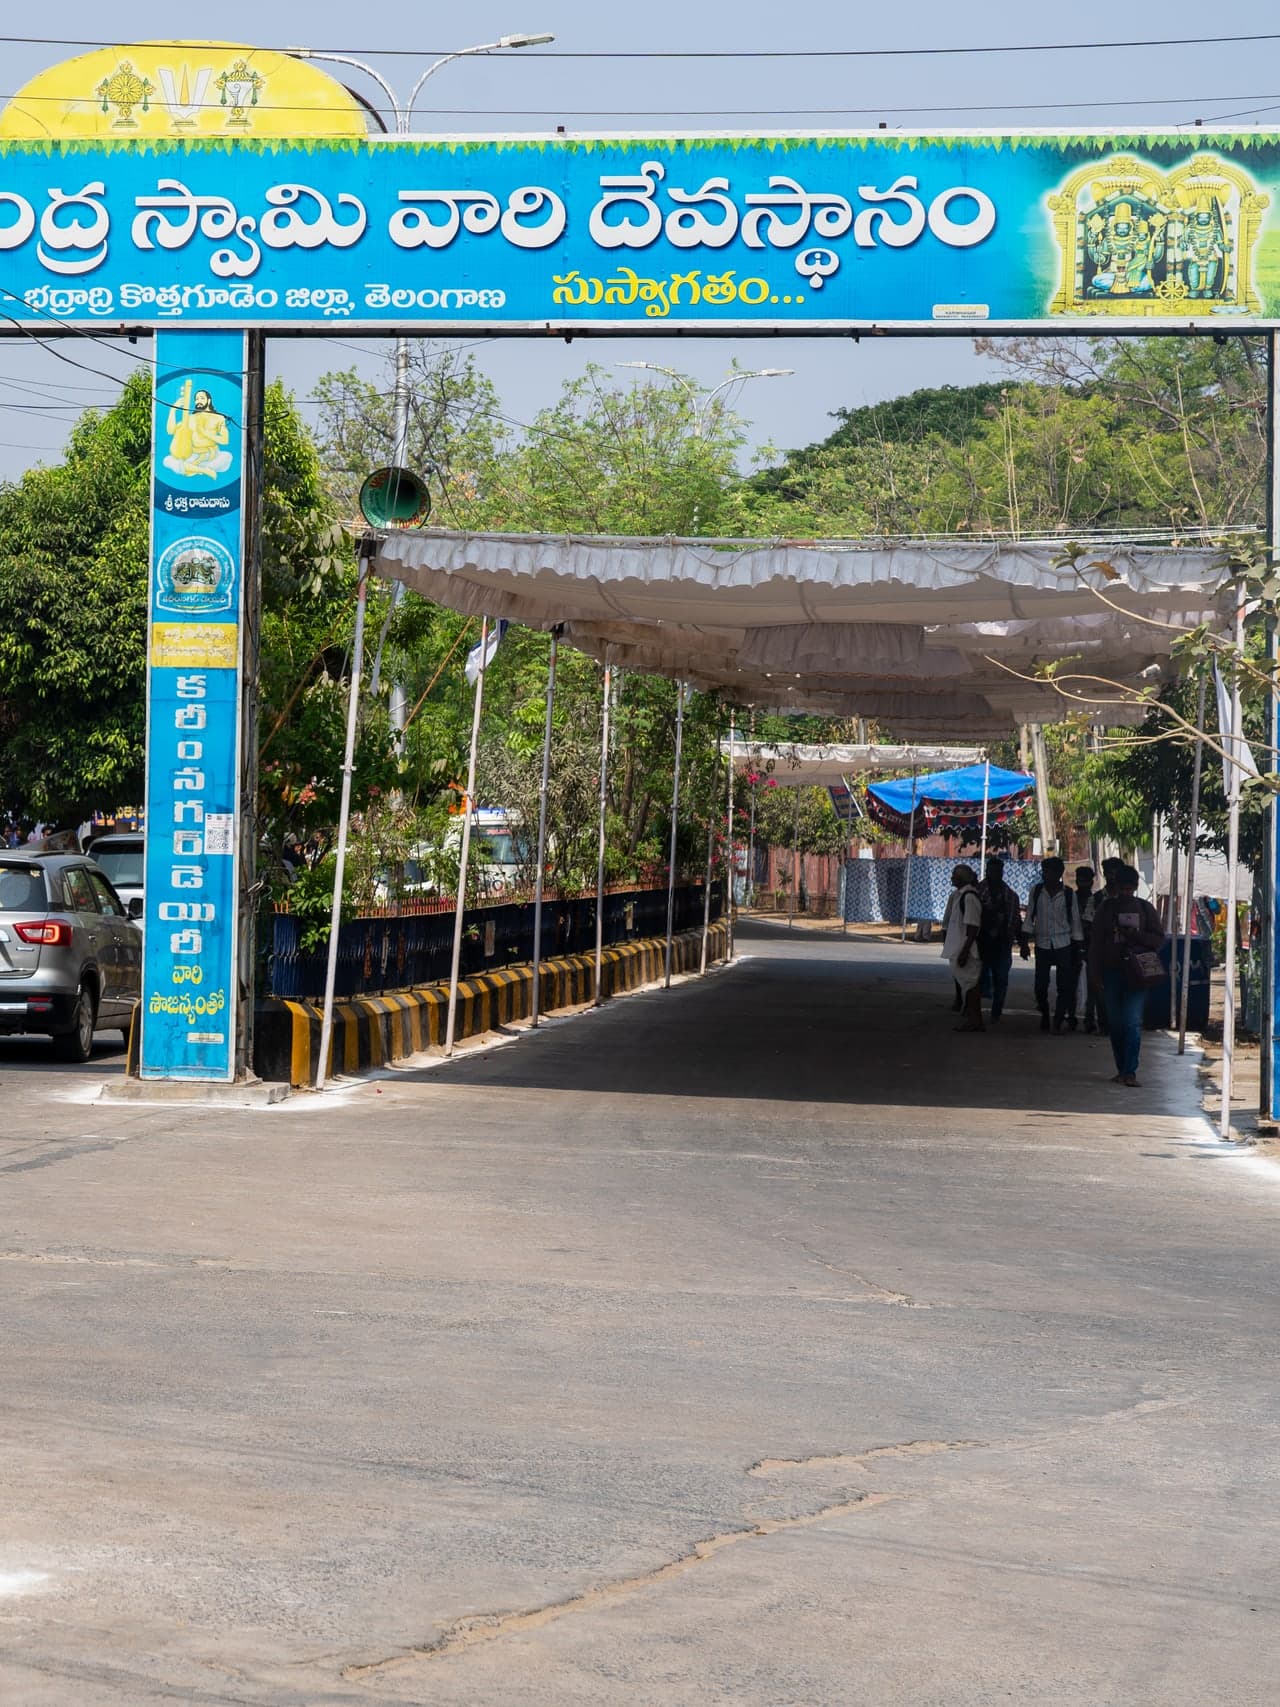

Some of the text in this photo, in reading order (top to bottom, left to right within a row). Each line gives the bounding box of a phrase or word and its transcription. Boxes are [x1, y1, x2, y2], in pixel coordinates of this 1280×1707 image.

[131, 178, 367, 278] స్వామి
[389, 186, 566, 248] వారి
[588, 161, 996, 288] దేవస్థానం
[24, 284, 114, 316] భద్రాద్రి
[119, 283, 278, 317] కొత్తగూడెం
[365, 283, 506, 310] తెలంగాణ
[164, 494, 173, 511] శ్రీ
[172, 964, 203, 985] వారి
